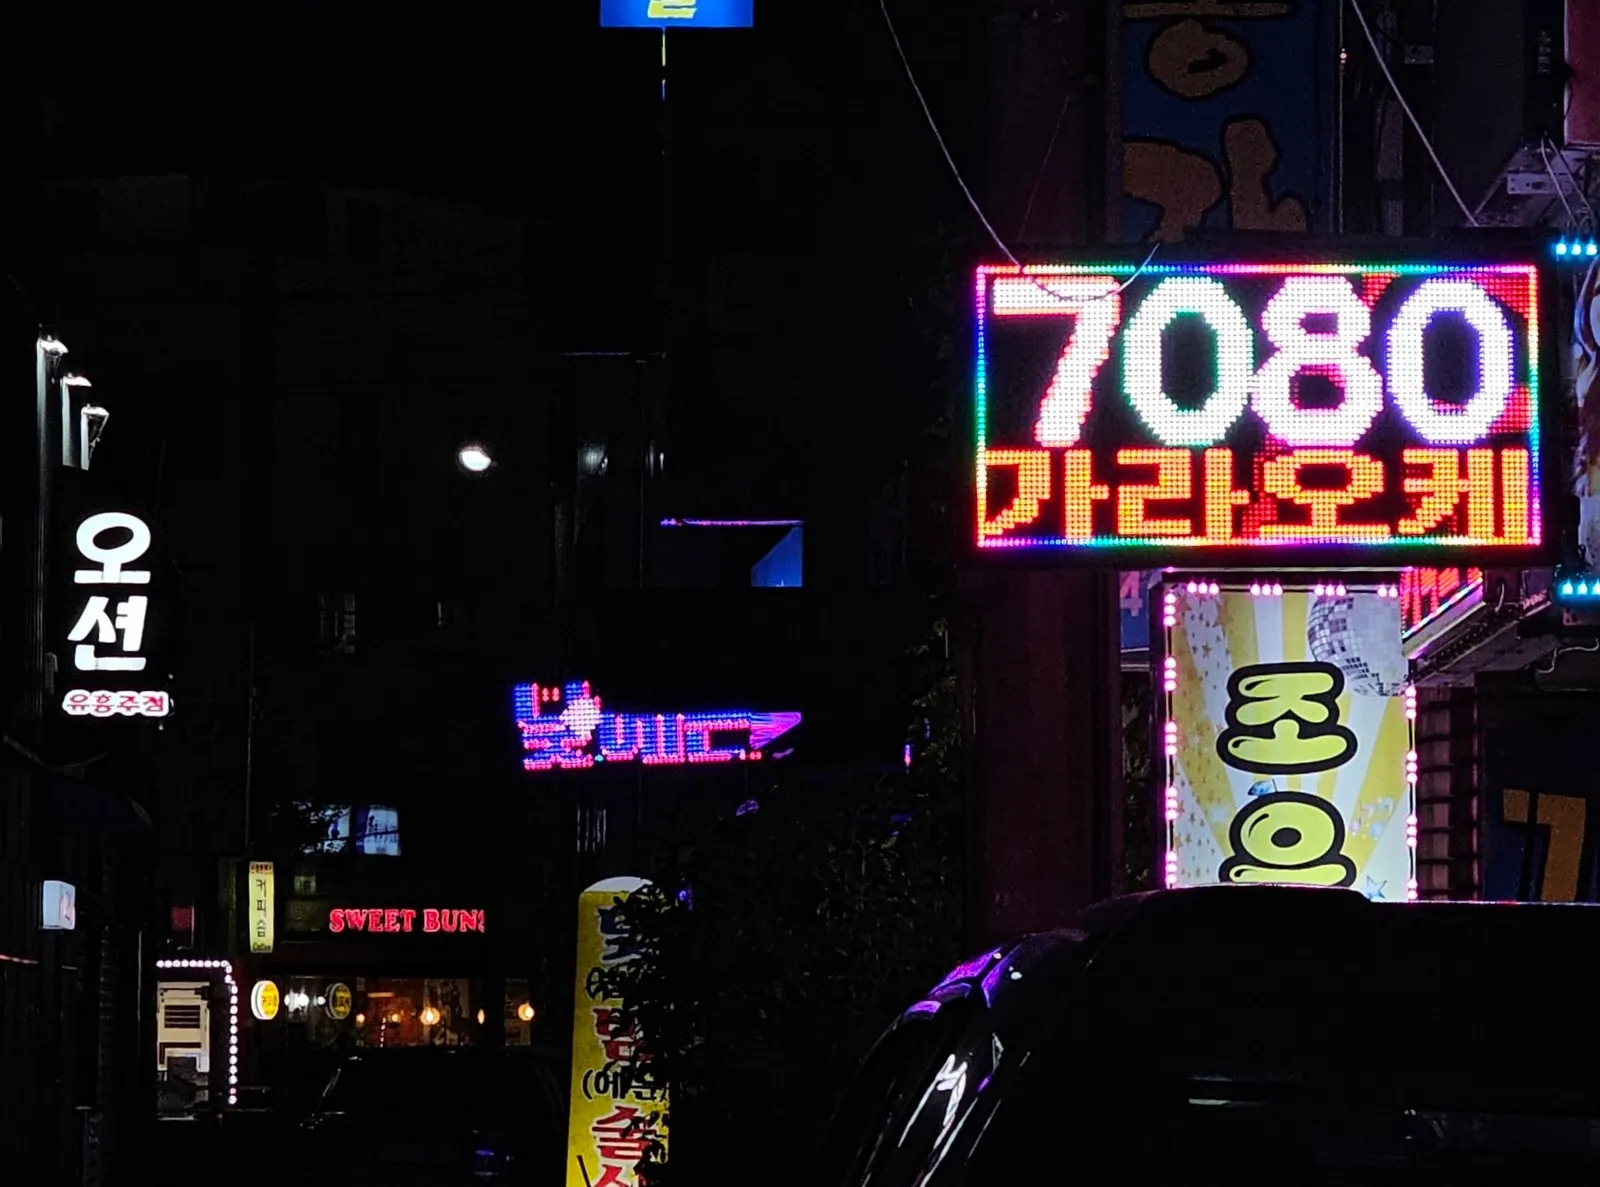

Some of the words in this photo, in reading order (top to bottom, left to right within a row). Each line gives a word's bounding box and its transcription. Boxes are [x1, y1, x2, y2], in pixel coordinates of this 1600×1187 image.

[993, 275, 1514, 447] 7080
[984, 448, 1529, 541] 가라오케
[67, 511, 151, 671] 오션
[329, 908, 416, 933] SWEET
